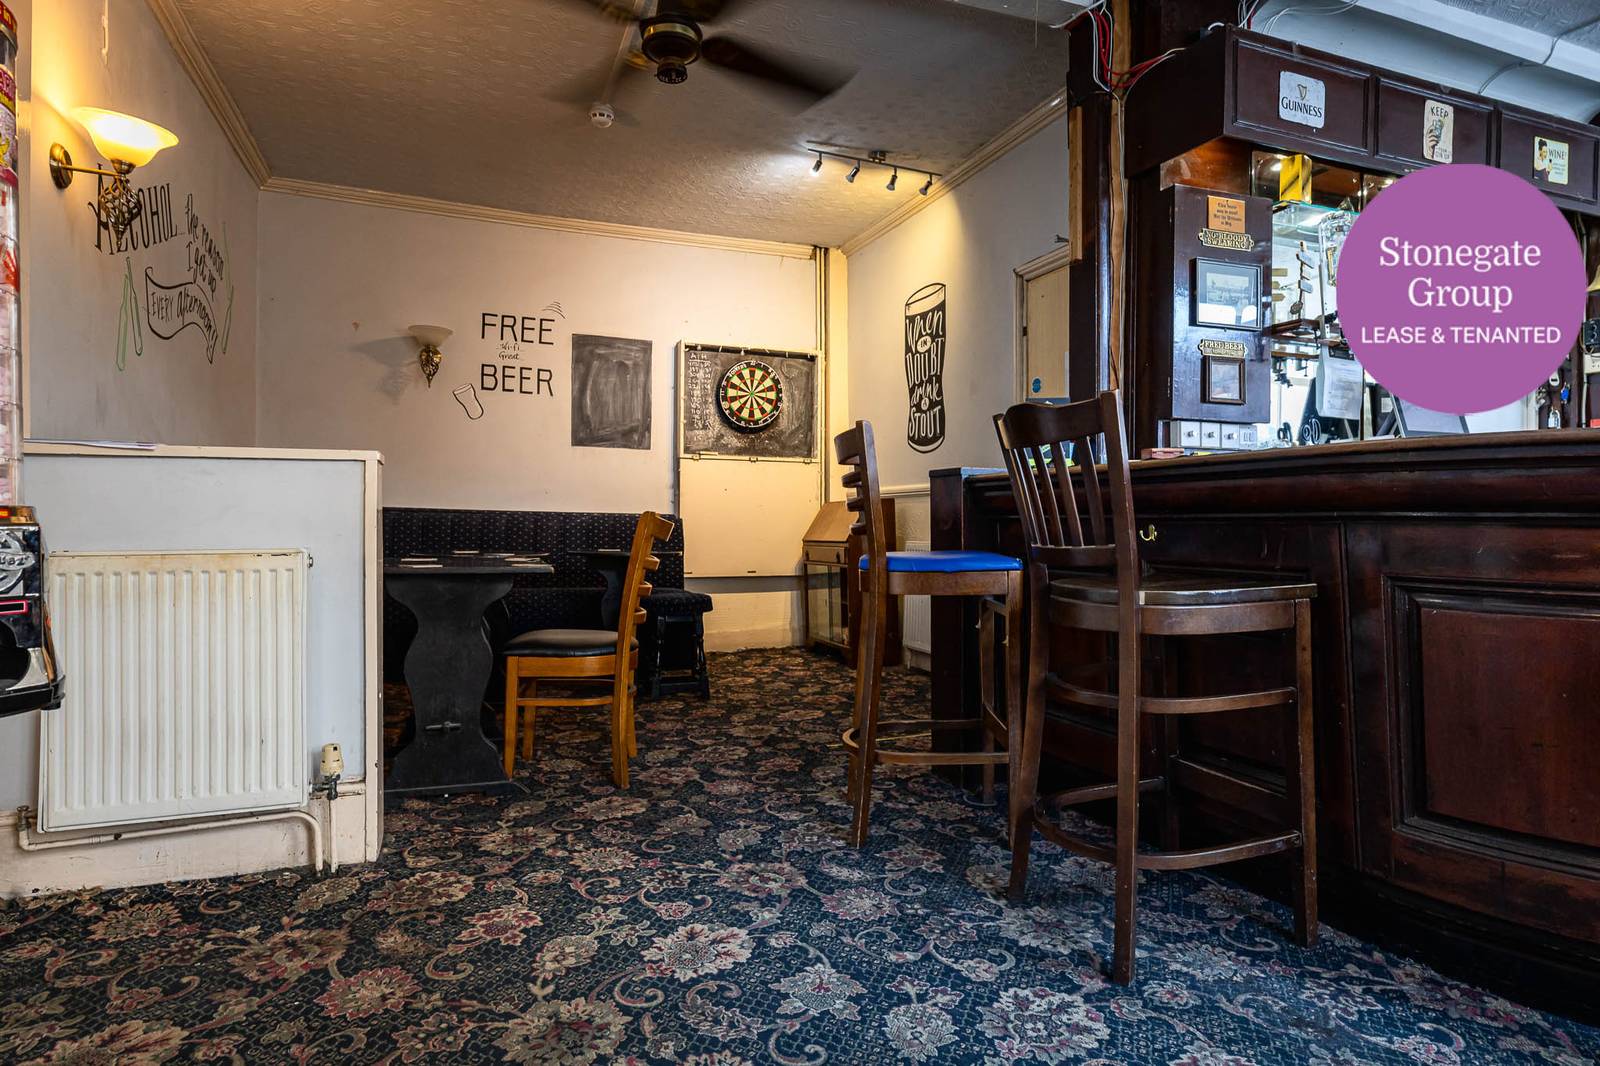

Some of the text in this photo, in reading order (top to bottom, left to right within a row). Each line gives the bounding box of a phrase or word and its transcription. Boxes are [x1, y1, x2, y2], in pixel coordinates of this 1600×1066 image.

[1281, 96, 1322, 118] GUINNESS
[1430, 106, 1449, 119] KEEP
[151, 291, 173, 323] EVERY
[481, 312, 555, 346] FREE
[906, 309, 943, 354] When
[480, 363, 554, 397] BEER
[905, 337, 945, 389] DOUBT
[910, 376, 942, 406] drink
[908, 405, 942, 440] STOUT
